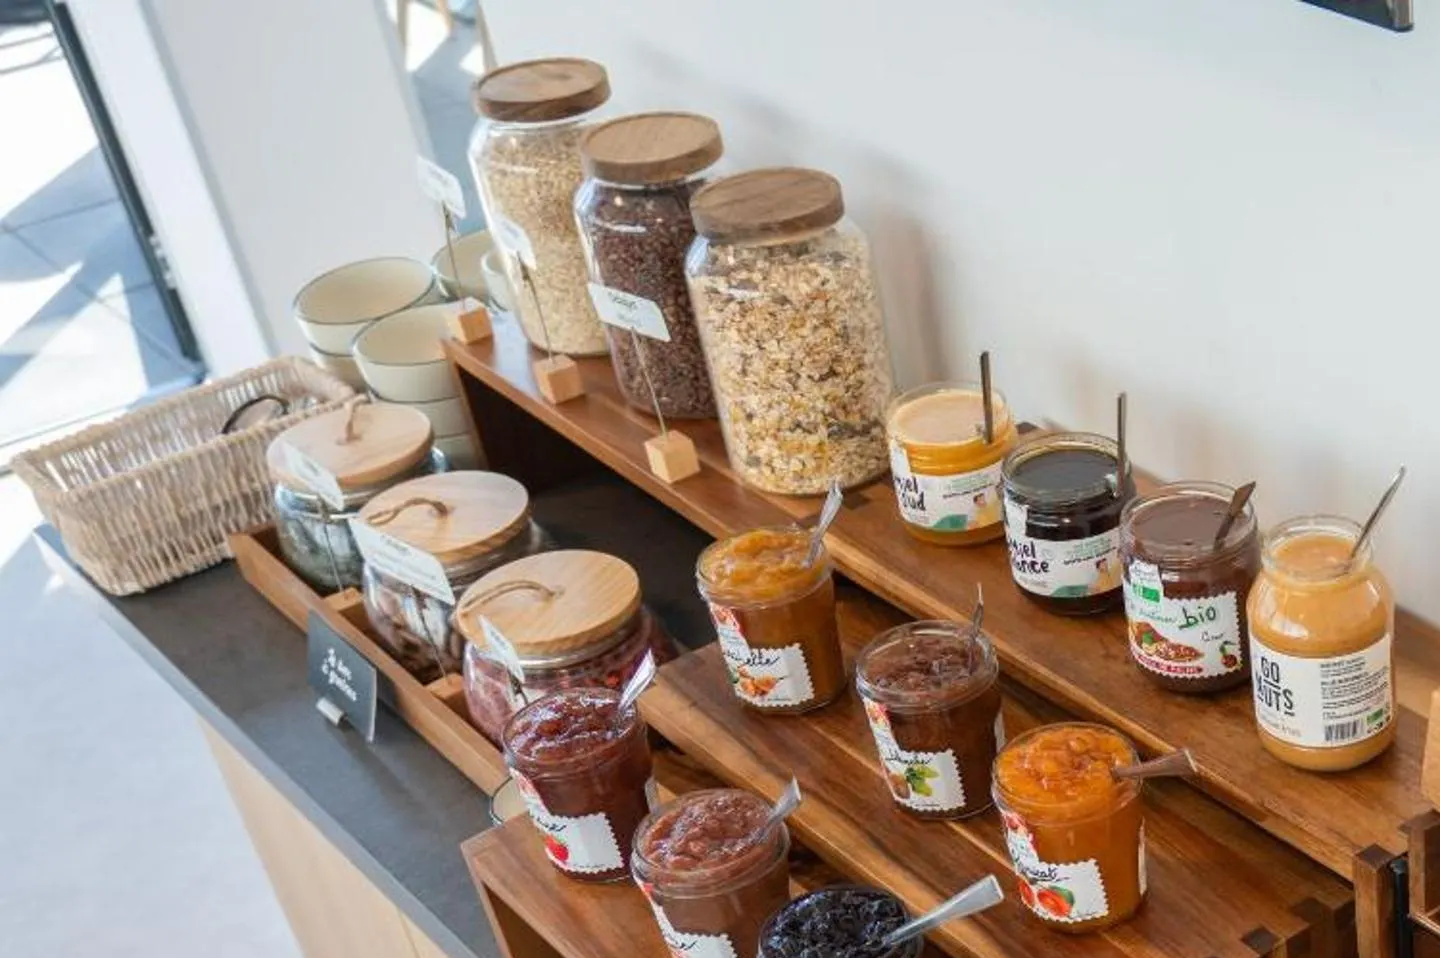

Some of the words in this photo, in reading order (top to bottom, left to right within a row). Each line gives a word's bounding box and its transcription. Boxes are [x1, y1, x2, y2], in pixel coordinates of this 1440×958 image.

[1179, 605, 1217, 630] bio
[1261, 655, 1281, 684] GO
[1256, 670, 1294, 712] NUTS
